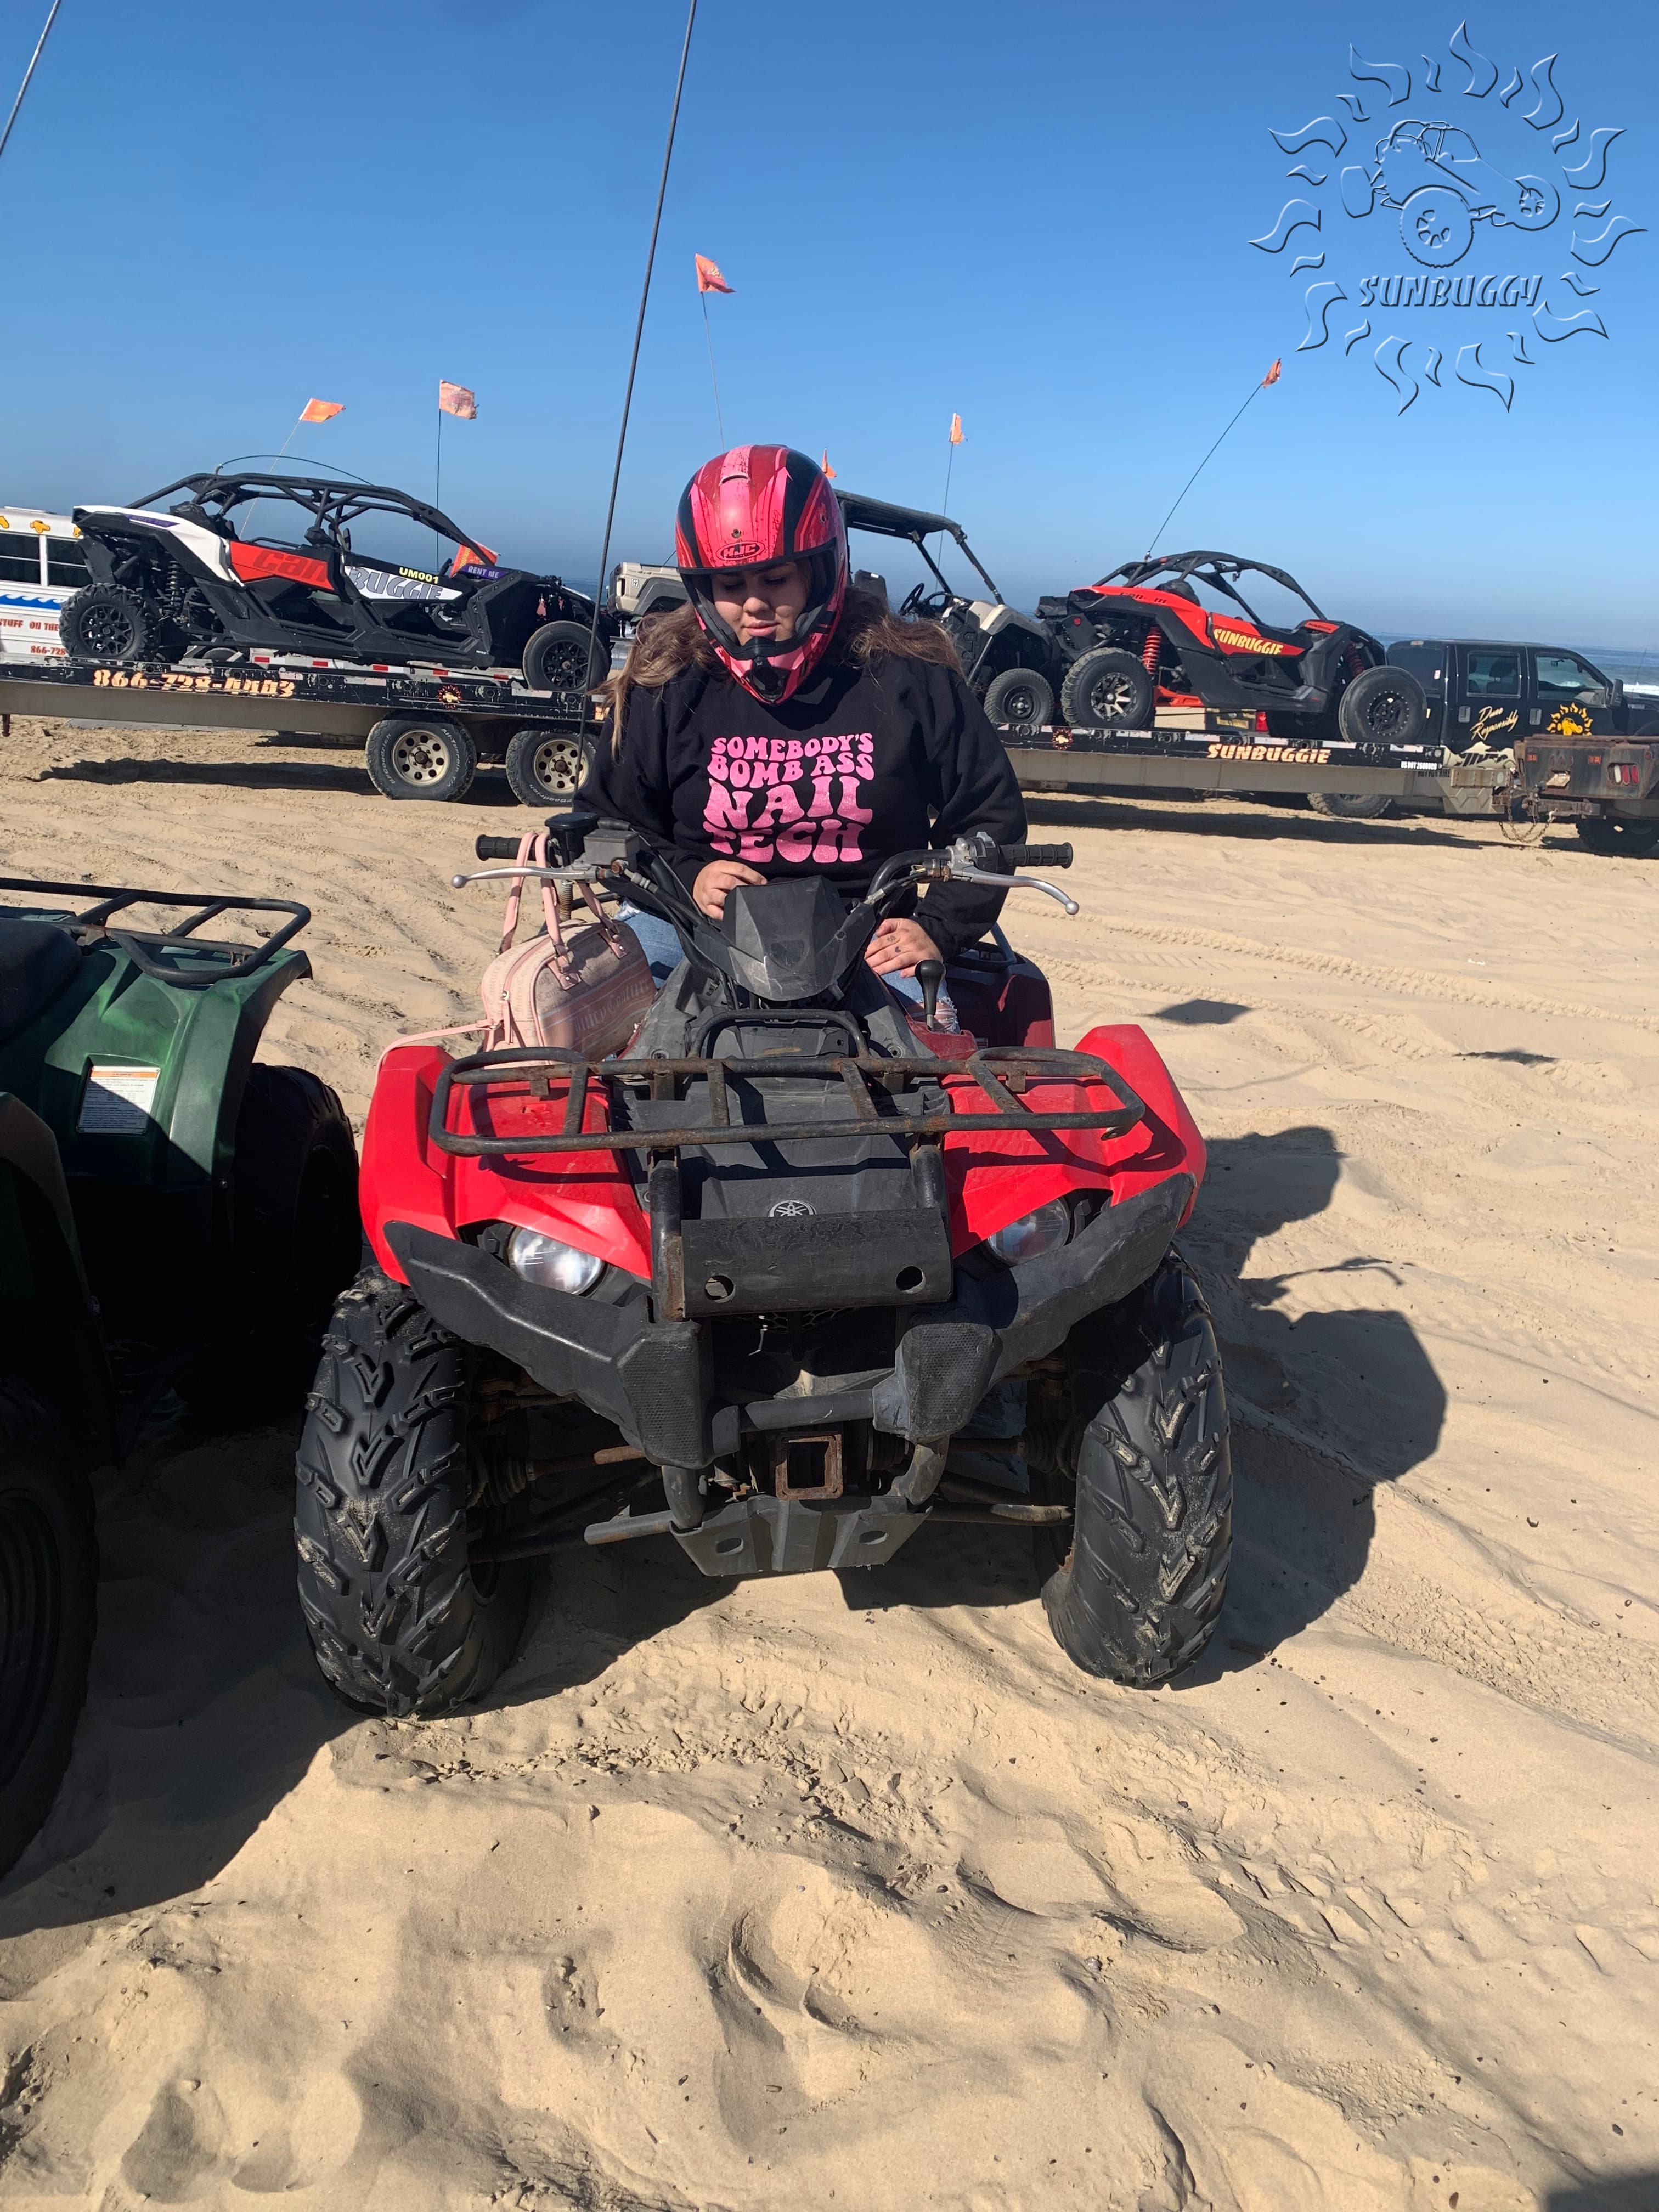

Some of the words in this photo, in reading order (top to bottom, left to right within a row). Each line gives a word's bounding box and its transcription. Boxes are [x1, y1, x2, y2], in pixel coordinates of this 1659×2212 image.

[723, 544, 757, 557] HJC
[349, 567, 443, 599] BUGGIE
[399, 567, 439, 584] UM001
[468, 566, 487, 575] RENT
[488, 569, 500, 578] ME
[30, 621, 42, 630] ON
[44, 623, 59, 631] THE
[711, 732, 874, 761] SOMEBODY'S
[1206, 743, 1331, 764] SUNBUGGIE
[707, 754, 804, 788] BOMB
[810, 752, 874, 781] ASS
[703, 776, 873, 830] NAIL
[702, 819, 865, 864] TECH
